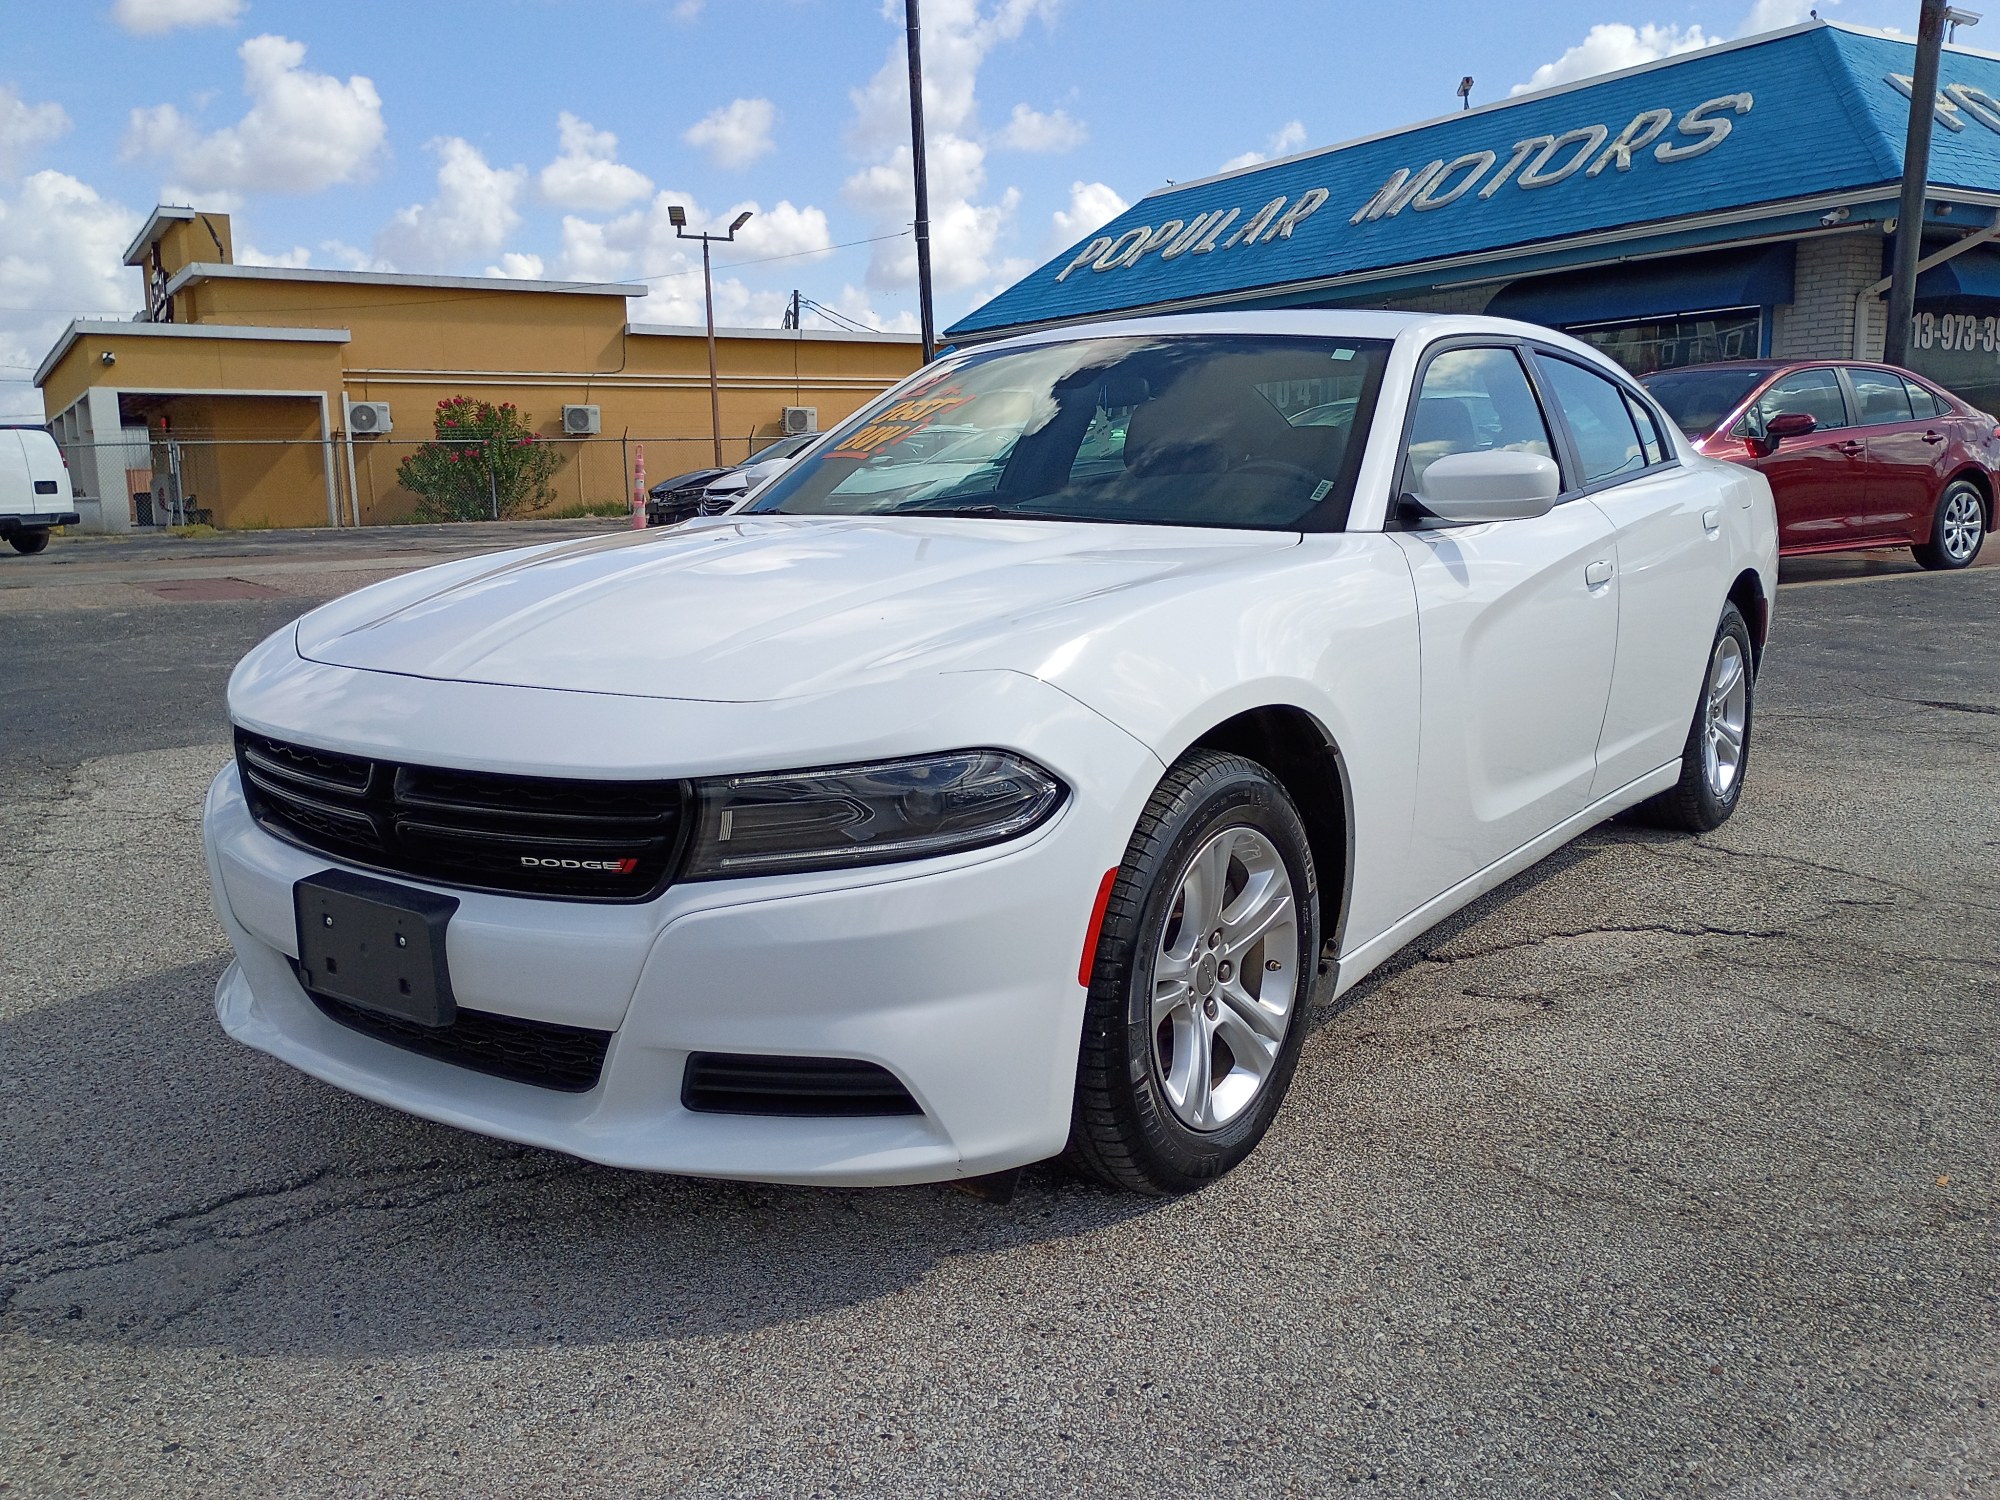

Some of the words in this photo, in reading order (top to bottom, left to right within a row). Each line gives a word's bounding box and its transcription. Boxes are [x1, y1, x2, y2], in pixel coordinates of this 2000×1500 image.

[1055, 188, 1330, 282] POPULAR
[1348, 92, 1754, 226] MOTORS
[520, 856, 623, 870] DODGE
